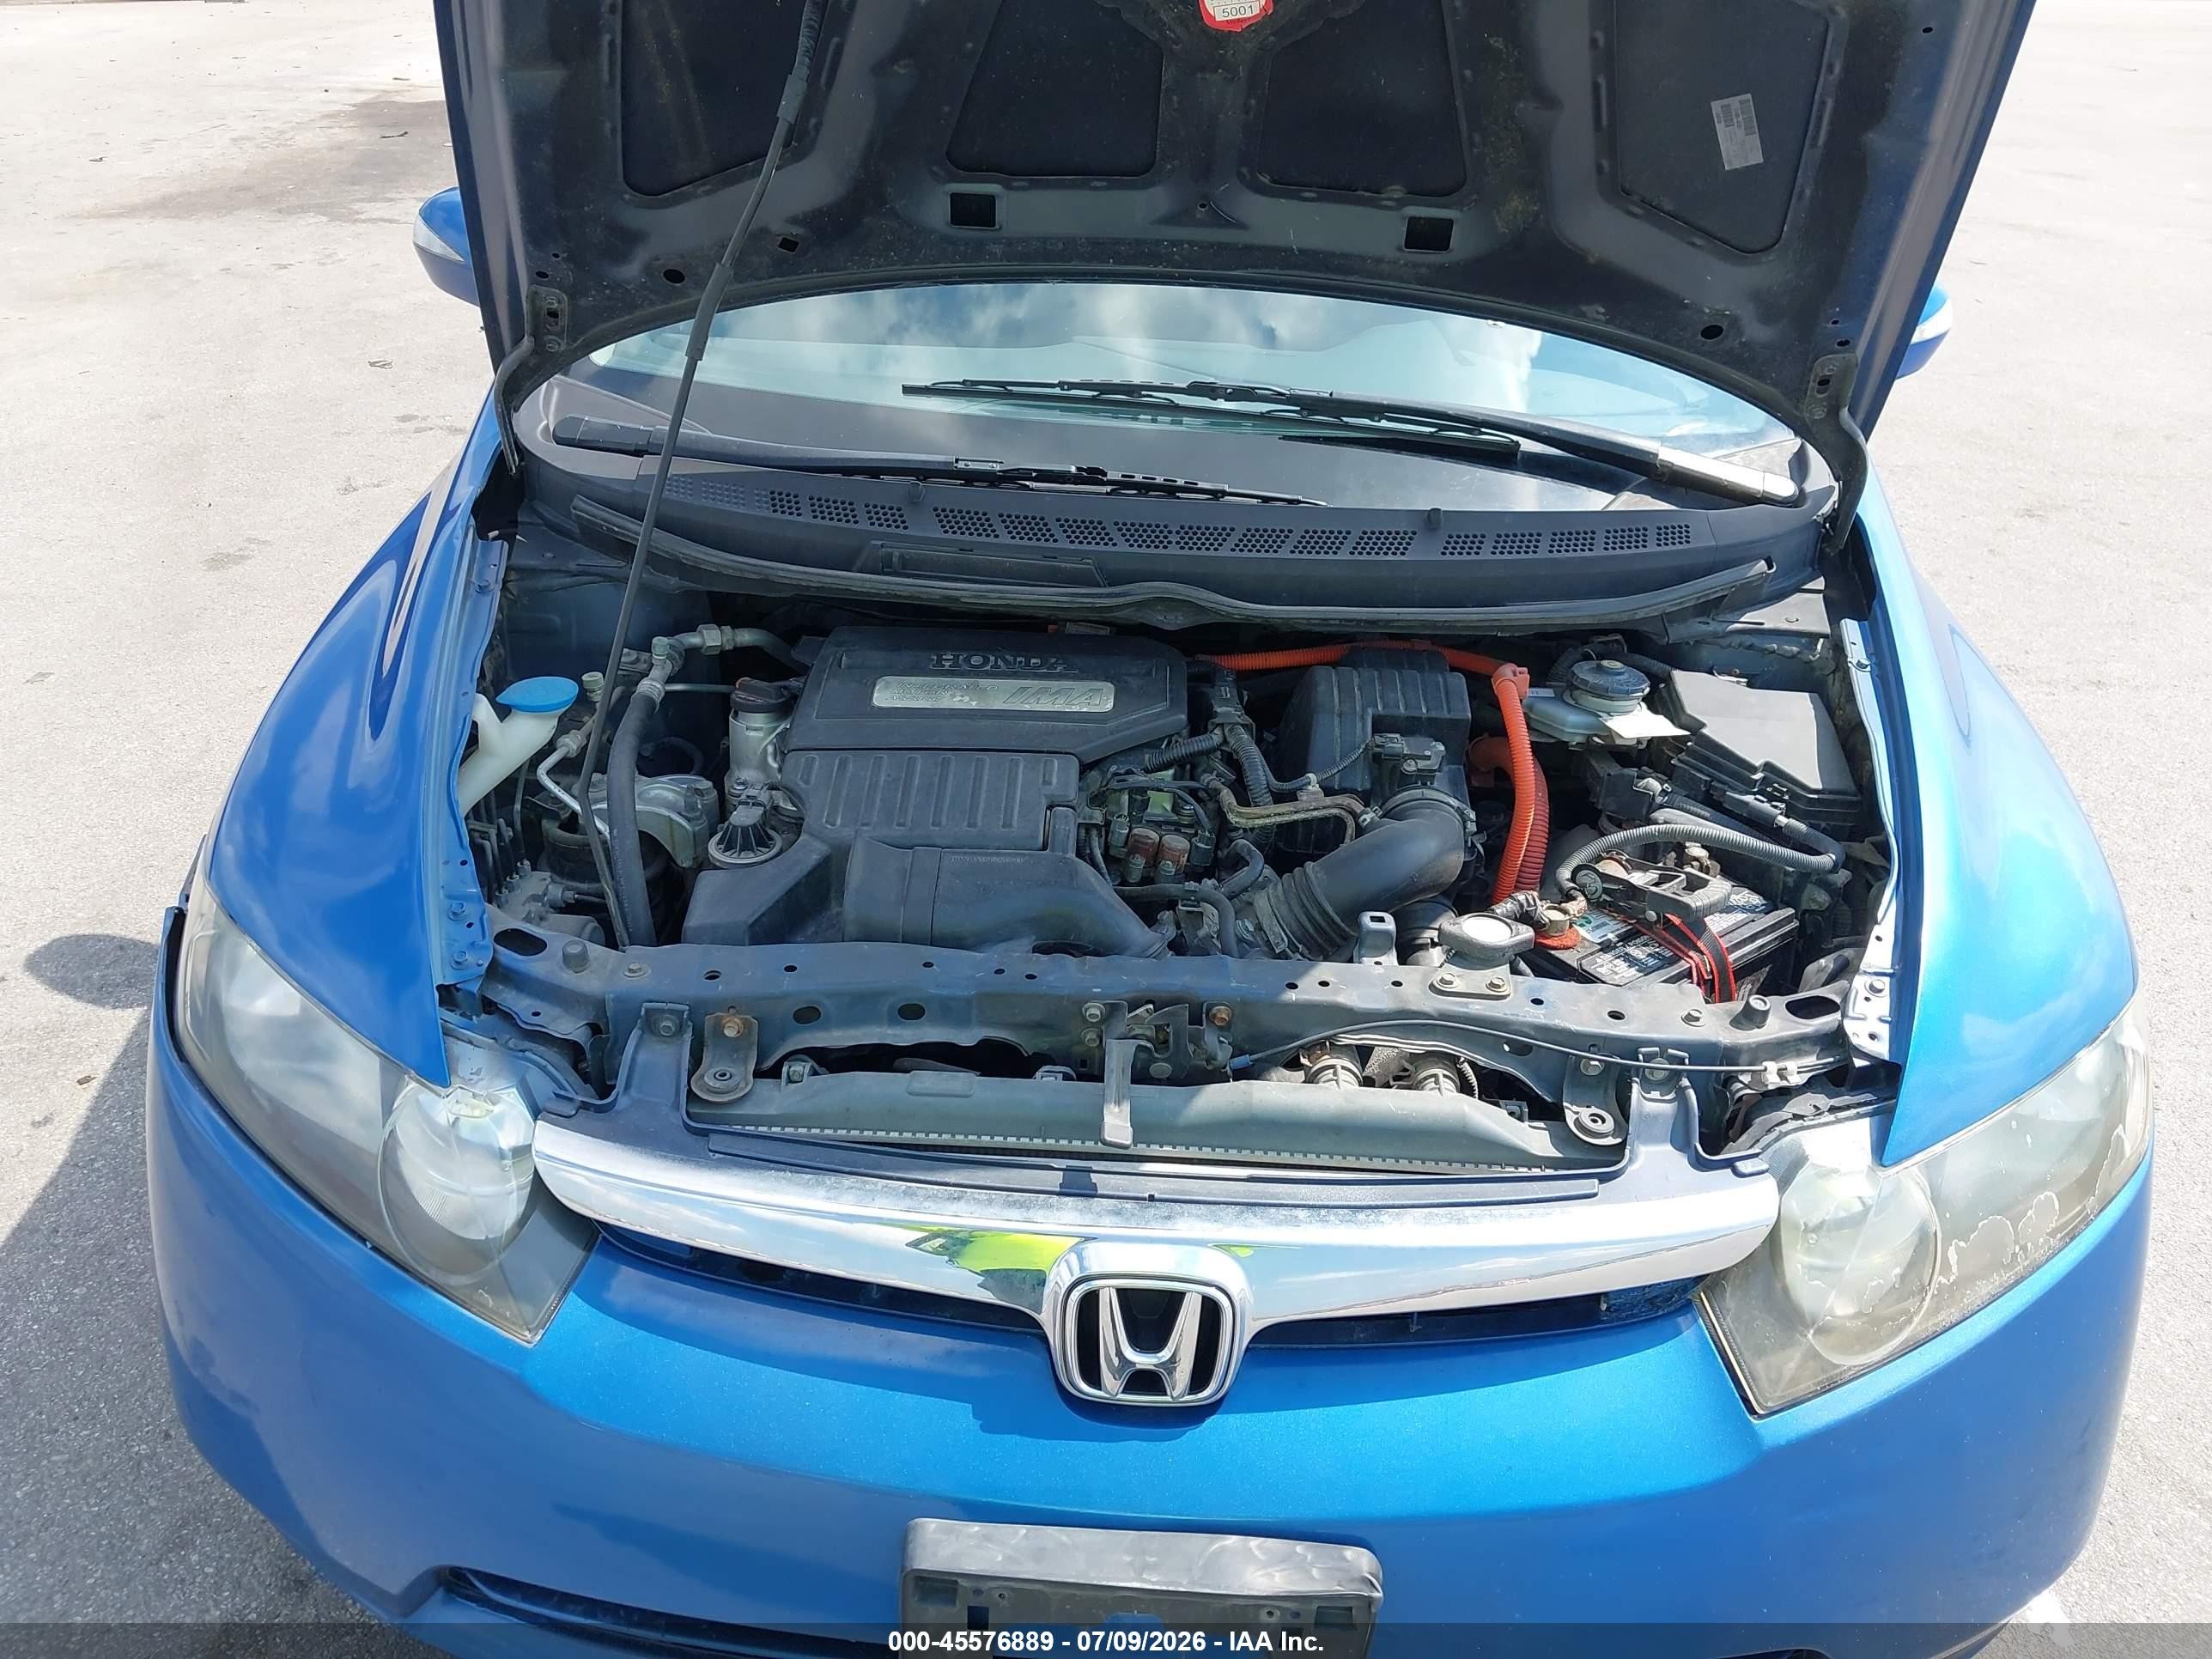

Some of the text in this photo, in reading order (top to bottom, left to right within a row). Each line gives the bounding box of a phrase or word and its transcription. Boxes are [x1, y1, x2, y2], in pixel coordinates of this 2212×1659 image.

[1222, 5, 1255, 18] 5001
[929, 652, 1079, 673] HONDA
[1002, 686, 1103, 707] IMA
